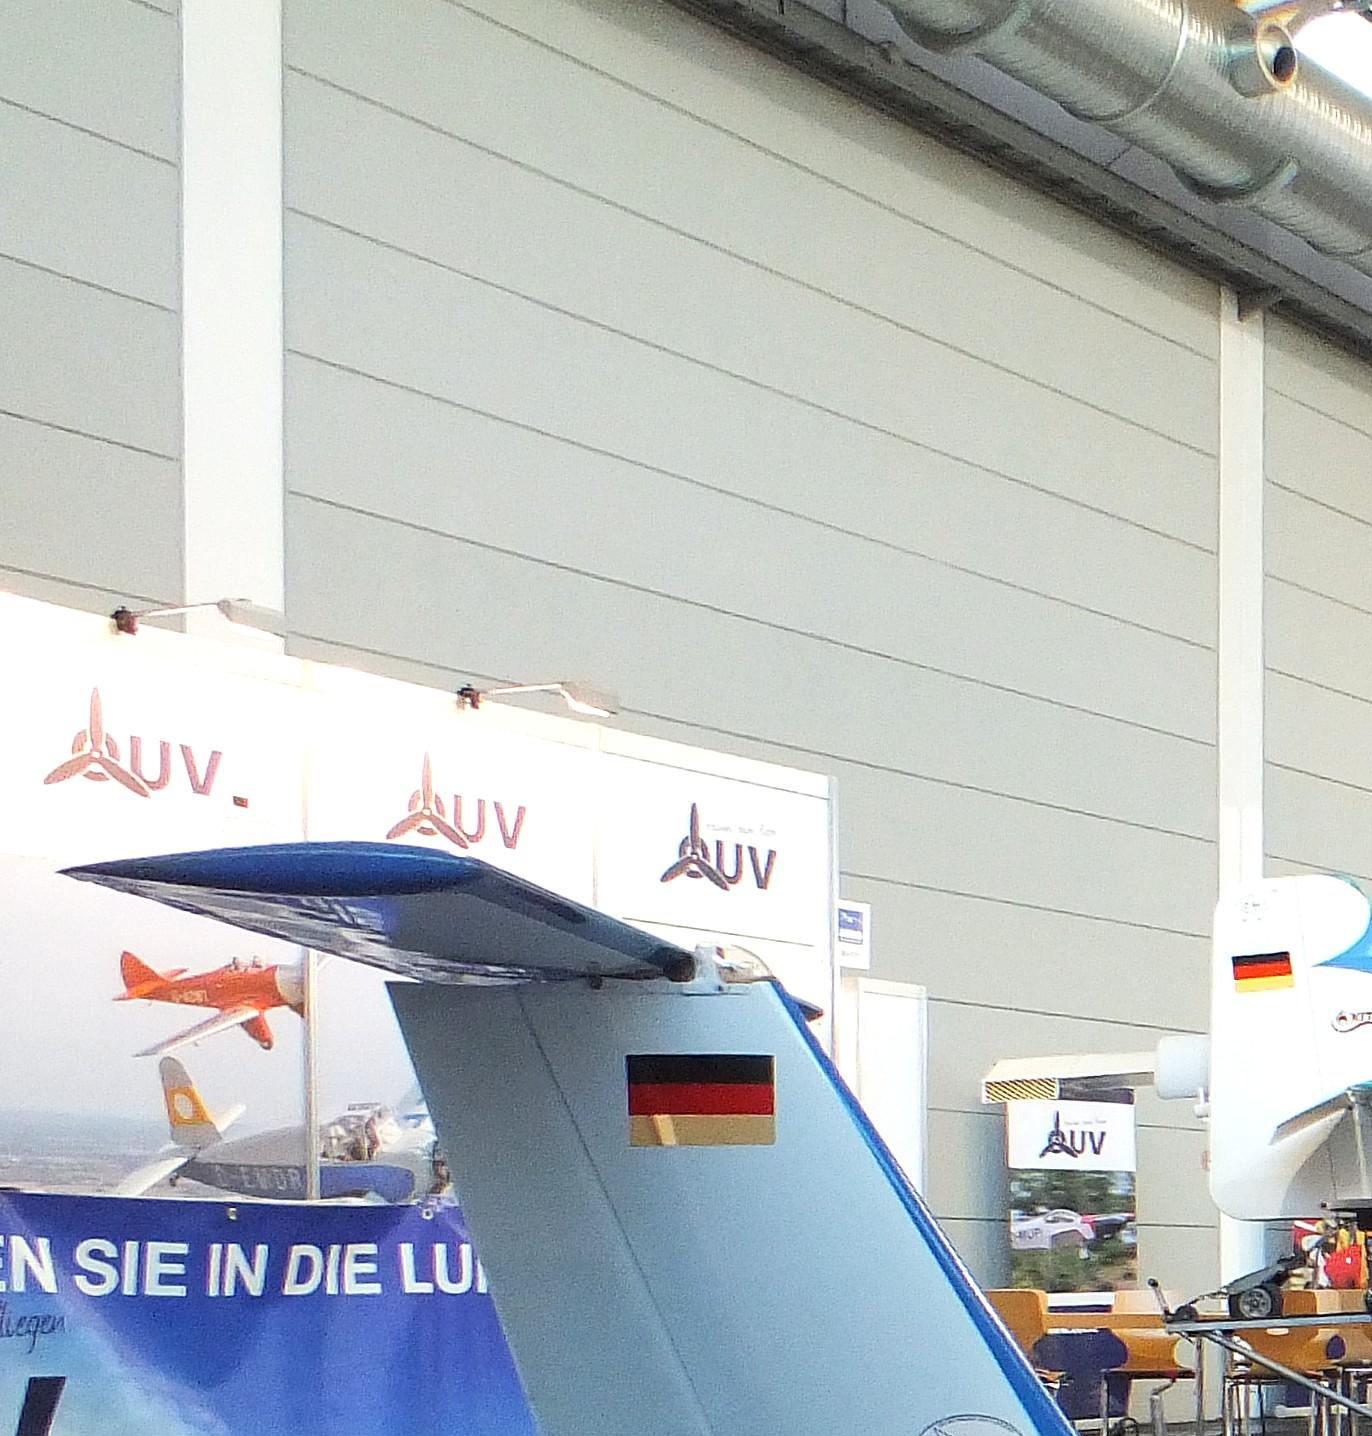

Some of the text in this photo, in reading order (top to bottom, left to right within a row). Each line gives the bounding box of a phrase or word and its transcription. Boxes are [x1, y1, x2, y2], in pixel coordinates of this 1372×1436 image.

[75, 1238, 188, 1297] SIE
[208, 1243, 269, 1297] IN
[283, 1244, 381, 1295] DIE
